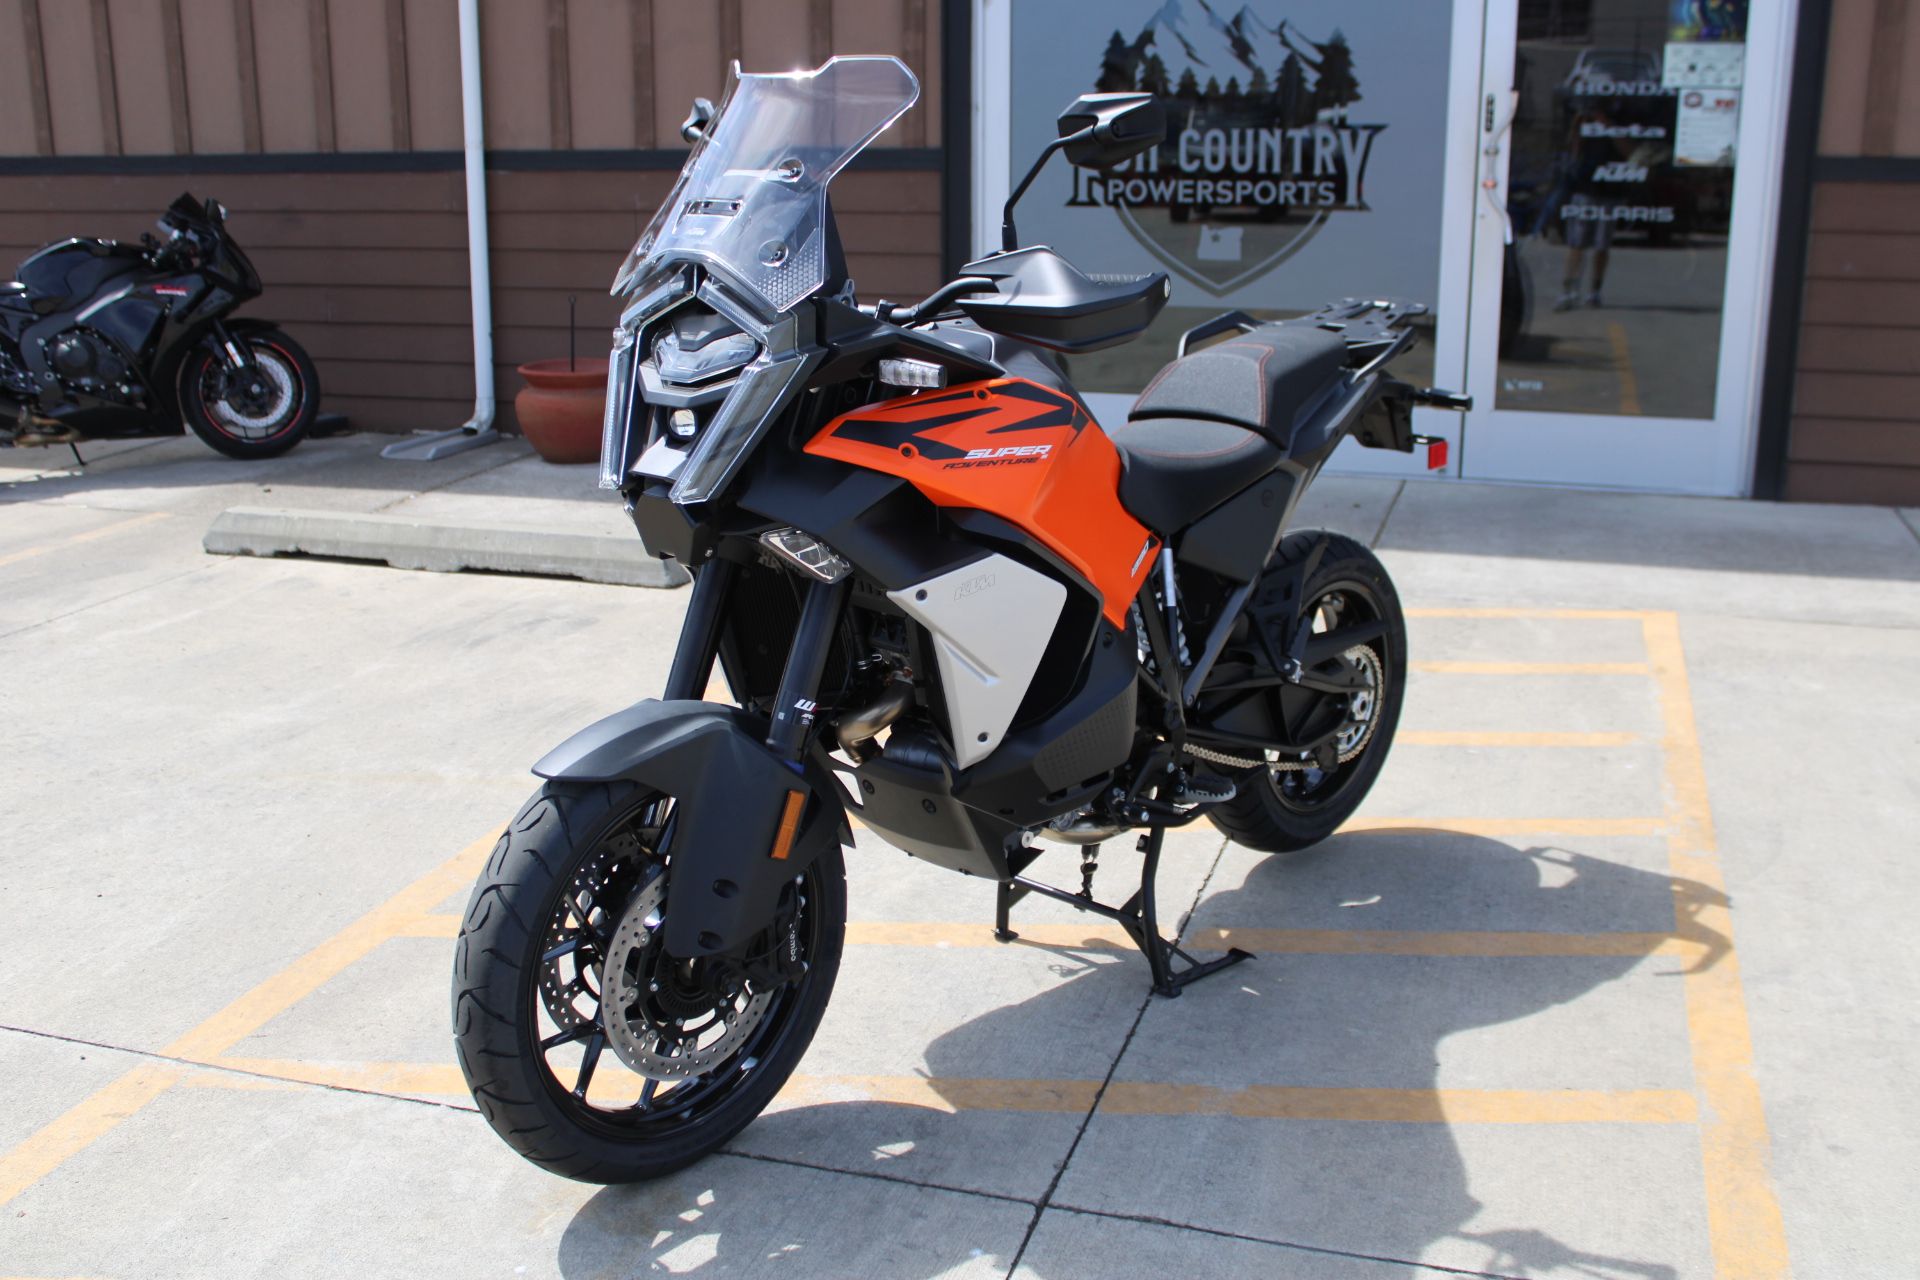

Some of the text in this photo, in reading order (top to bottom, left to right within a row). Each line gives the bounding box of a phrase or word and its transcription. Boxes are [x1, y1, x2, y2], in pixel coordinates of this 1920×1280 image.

[1178, 124, 1386, 209] COUNTRY
[1592, 162, 1648, 182] KTM
[1107, 178, 1337, 206] POWERSPORTS
[1561, 205, 1675, 222] POLARIS
[964, 445, 1053, 459] SUPER
[943, 458, 1039, 470] ADVENTURE
